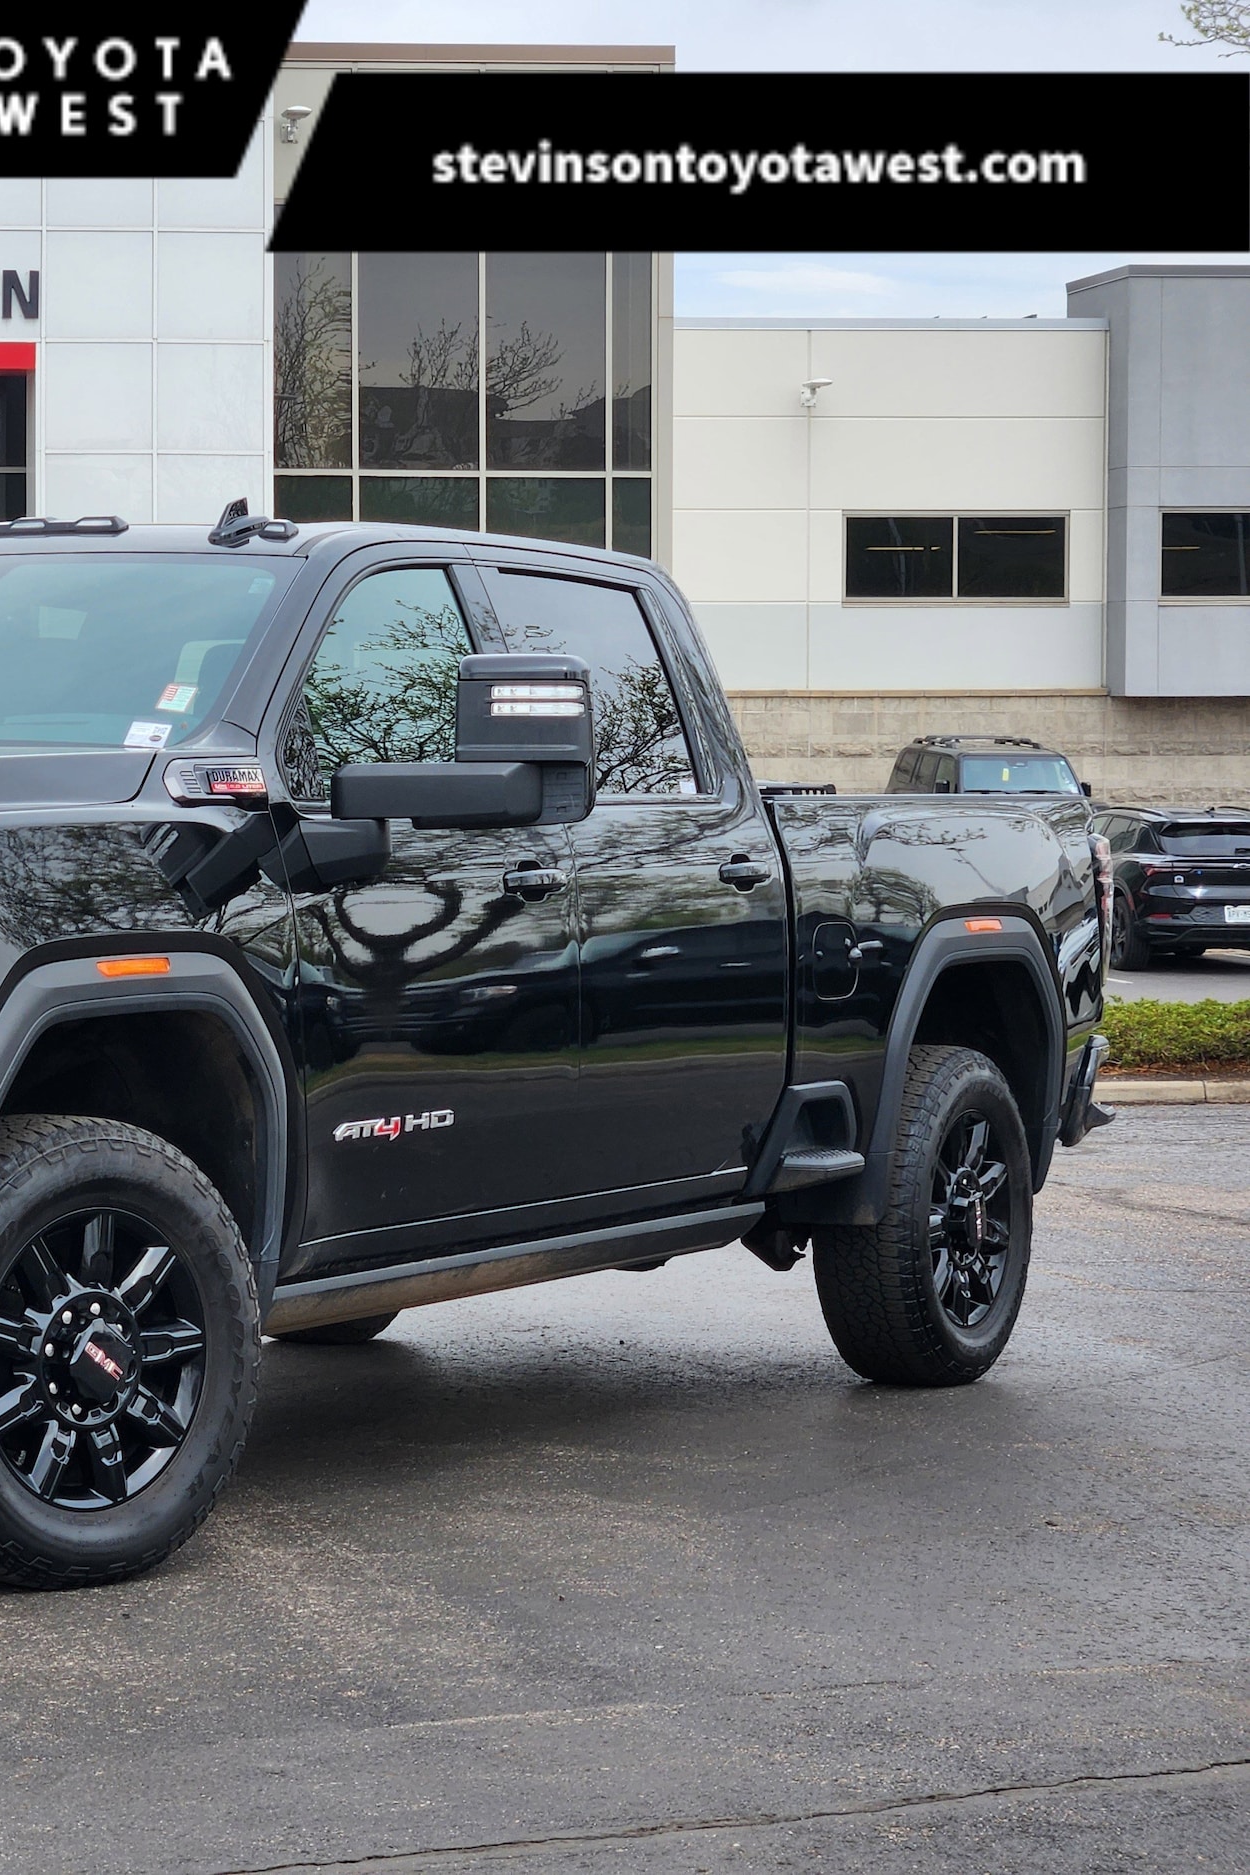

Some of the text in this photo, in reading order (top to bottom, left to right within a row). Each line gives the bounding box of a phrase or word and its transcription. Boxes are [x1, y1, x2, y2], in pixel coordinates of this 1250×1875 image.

[212, 770, 260, 782] DURAMAX
[332, 1109, 455, 1142] AT4 HD
[84, 1341, 123, 1381] GMC
